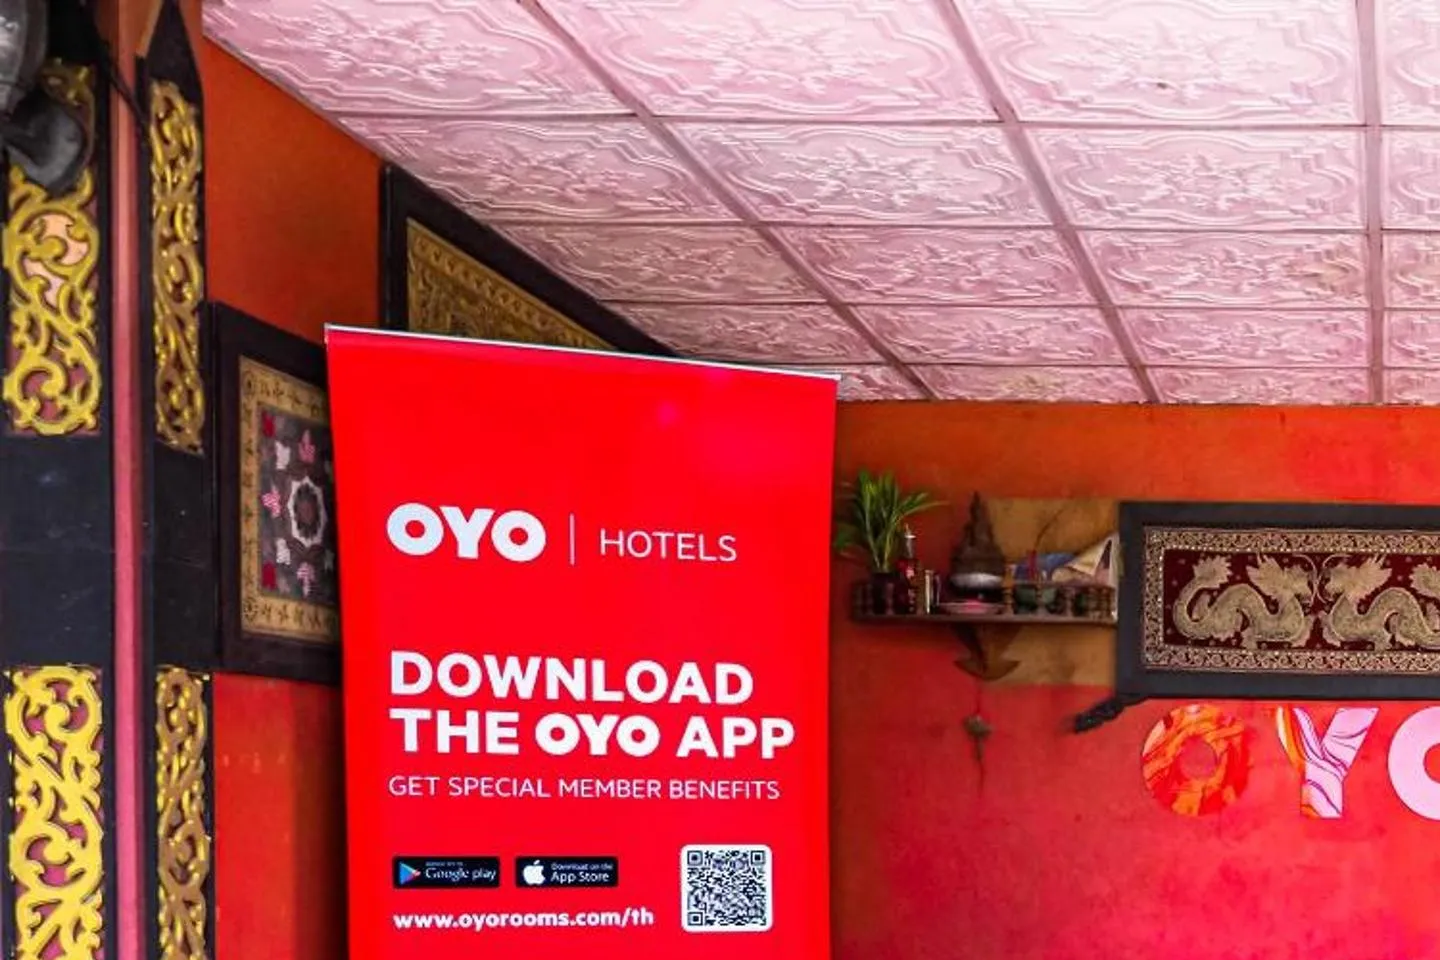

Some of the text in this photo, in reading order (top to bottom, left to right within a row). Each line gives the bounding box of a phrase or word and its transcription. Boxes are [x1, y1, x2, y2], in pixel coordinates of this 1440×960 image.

[386, 502, 738, 562] OYO HOTELS
[389, 650, 754, 705] DOWNLOAD
[389, 708, 795, 759] THE OYO APP
[388, 776, 780, 800] GET SPECIAL MEMBER BENEFITS
[425, 867, 496, 883] Google play
[551, 872, 610, 883] App Store
[393, 907, 655, 932] www.oyorooms.com/th
